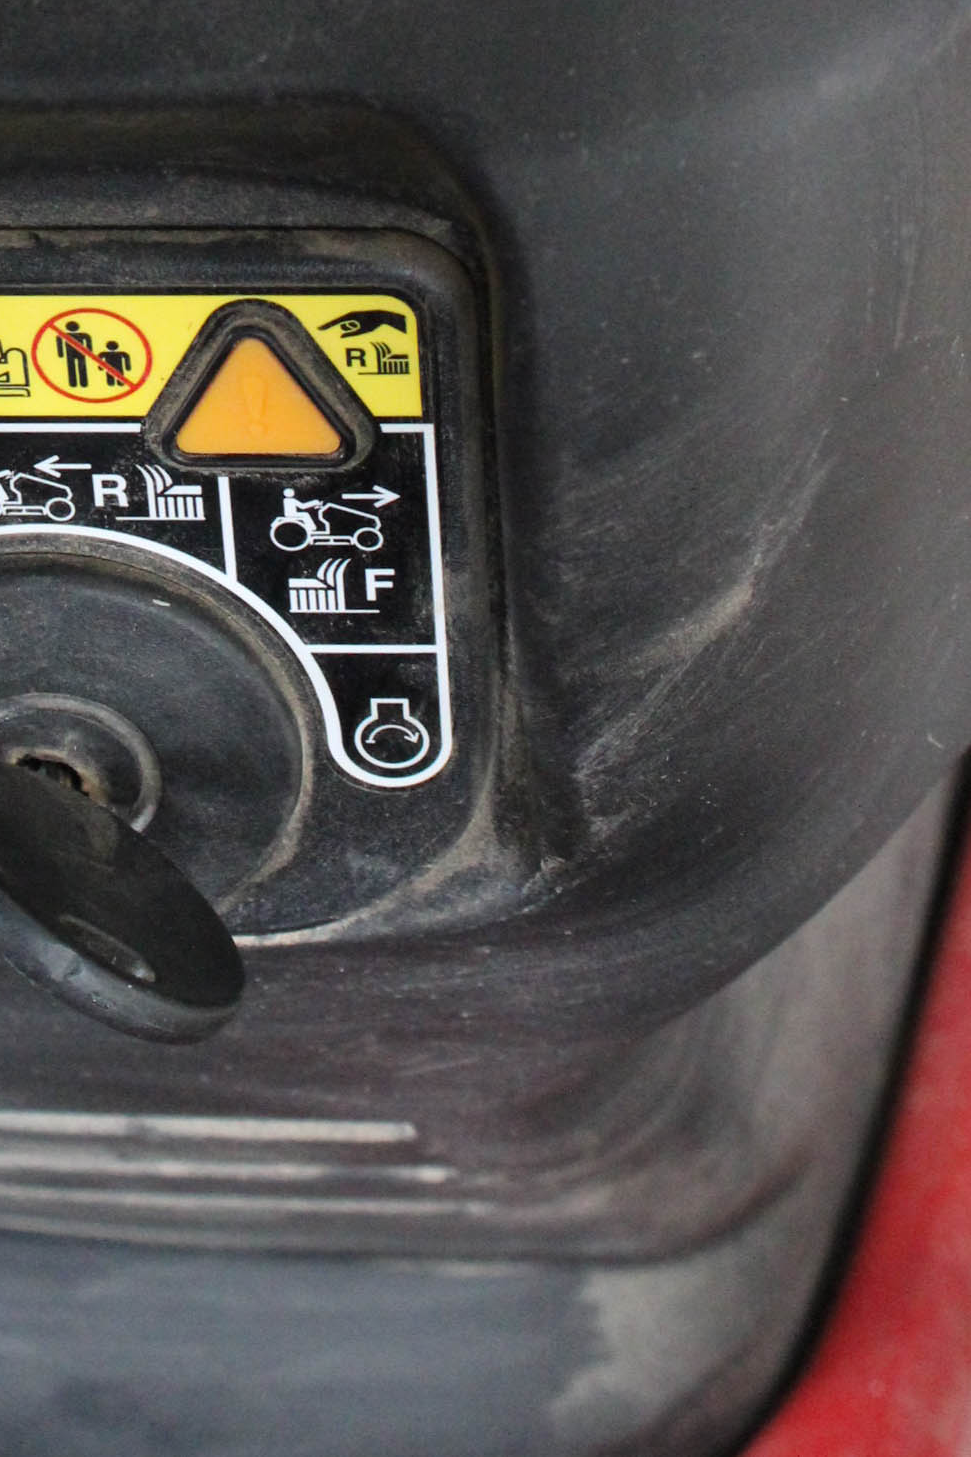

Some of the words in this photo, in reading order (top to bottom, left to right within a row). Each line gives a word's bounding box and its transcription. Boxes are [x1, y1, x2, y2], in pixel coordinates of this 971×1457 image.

[345, 347, 366, 367] R
[91, 473, 130, 507] R
[364, 568, 396, 601] F
